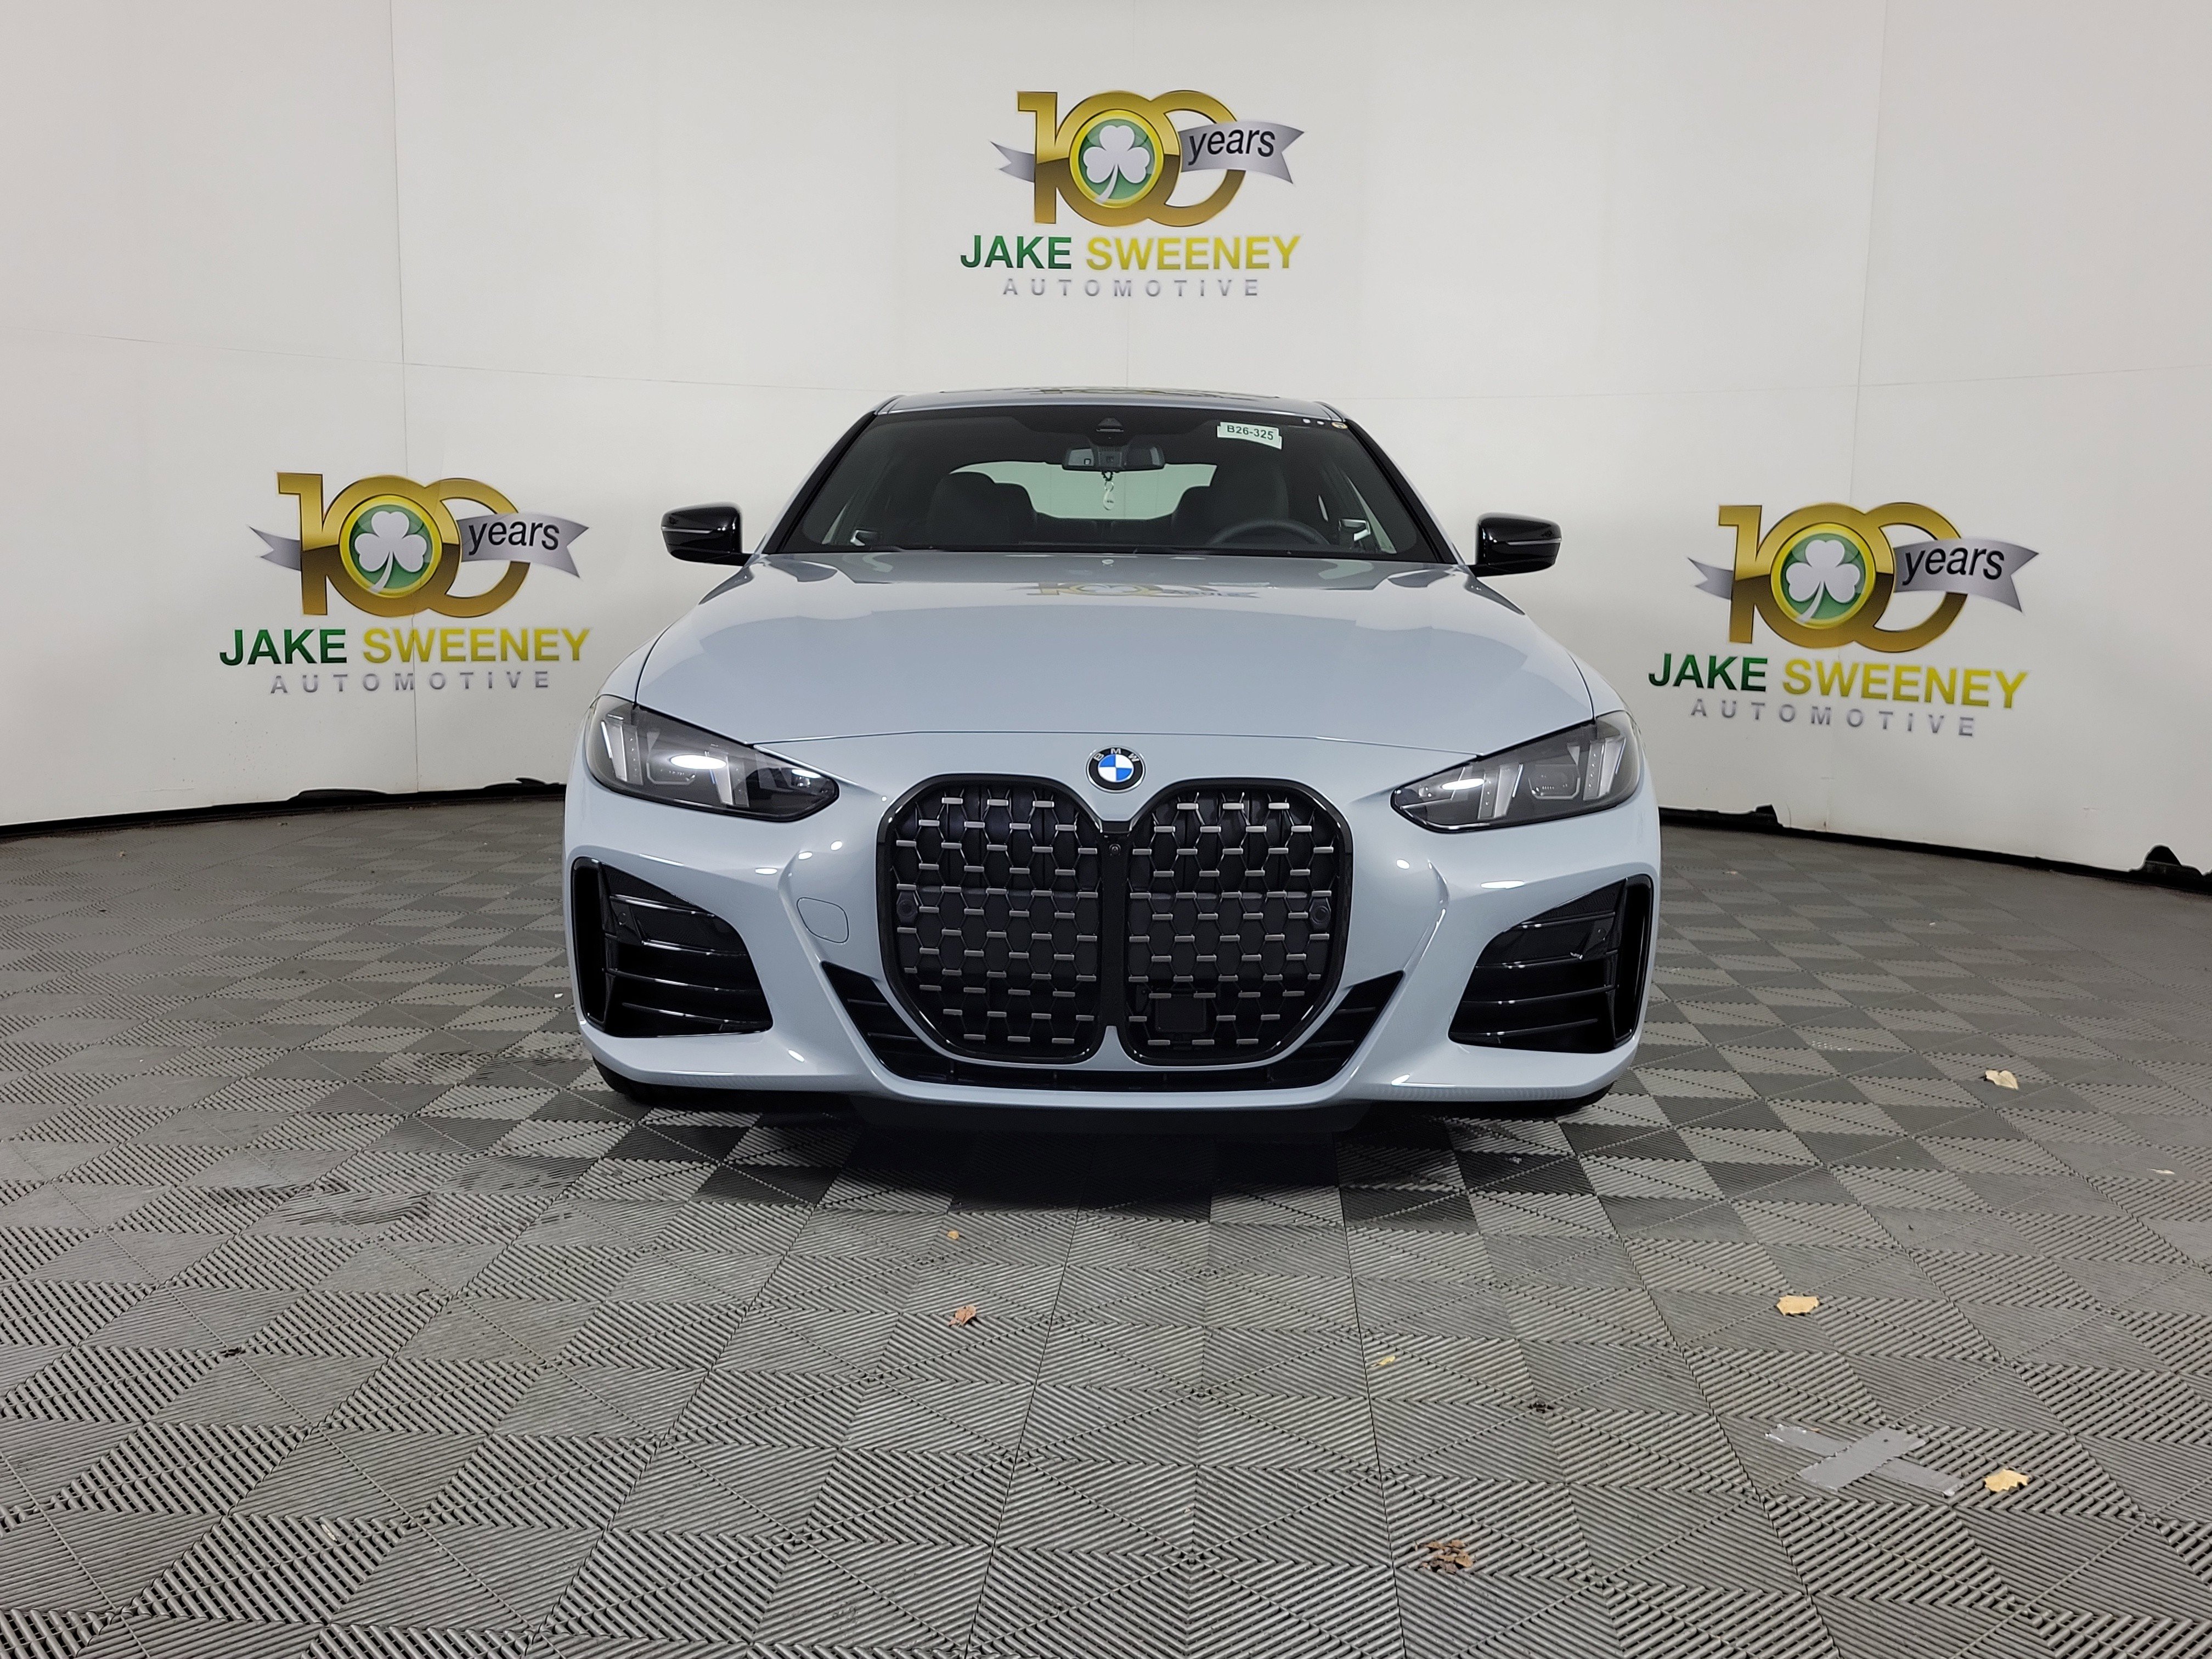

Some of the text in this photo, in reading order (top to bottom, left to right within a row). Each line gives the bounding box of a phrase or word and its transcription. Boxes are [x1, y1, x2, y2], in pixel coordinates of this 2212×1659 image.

[1017, 90, 1276, 227] 100 years
[960, 235, 1301, 270] JAKE SWEENEY
[1003, 278, 1258, 297] AUTOMOTIVE
[1227, 425, 1274, 441] B26-325
[276, 472, 560, 618] 100 years
[1718, 501, 2005, 653] 100 years
[219, 627, 591, 666] JAKE SWEENEY
[270, 670, 549, 694] AUTOMOTIVE
[1648, 653, 2028, 709] JAKE SWEENEY
[1690, 698, 1974, 737] AUTOMOTIVE
[1093, 748, 1140, 763] BMW
